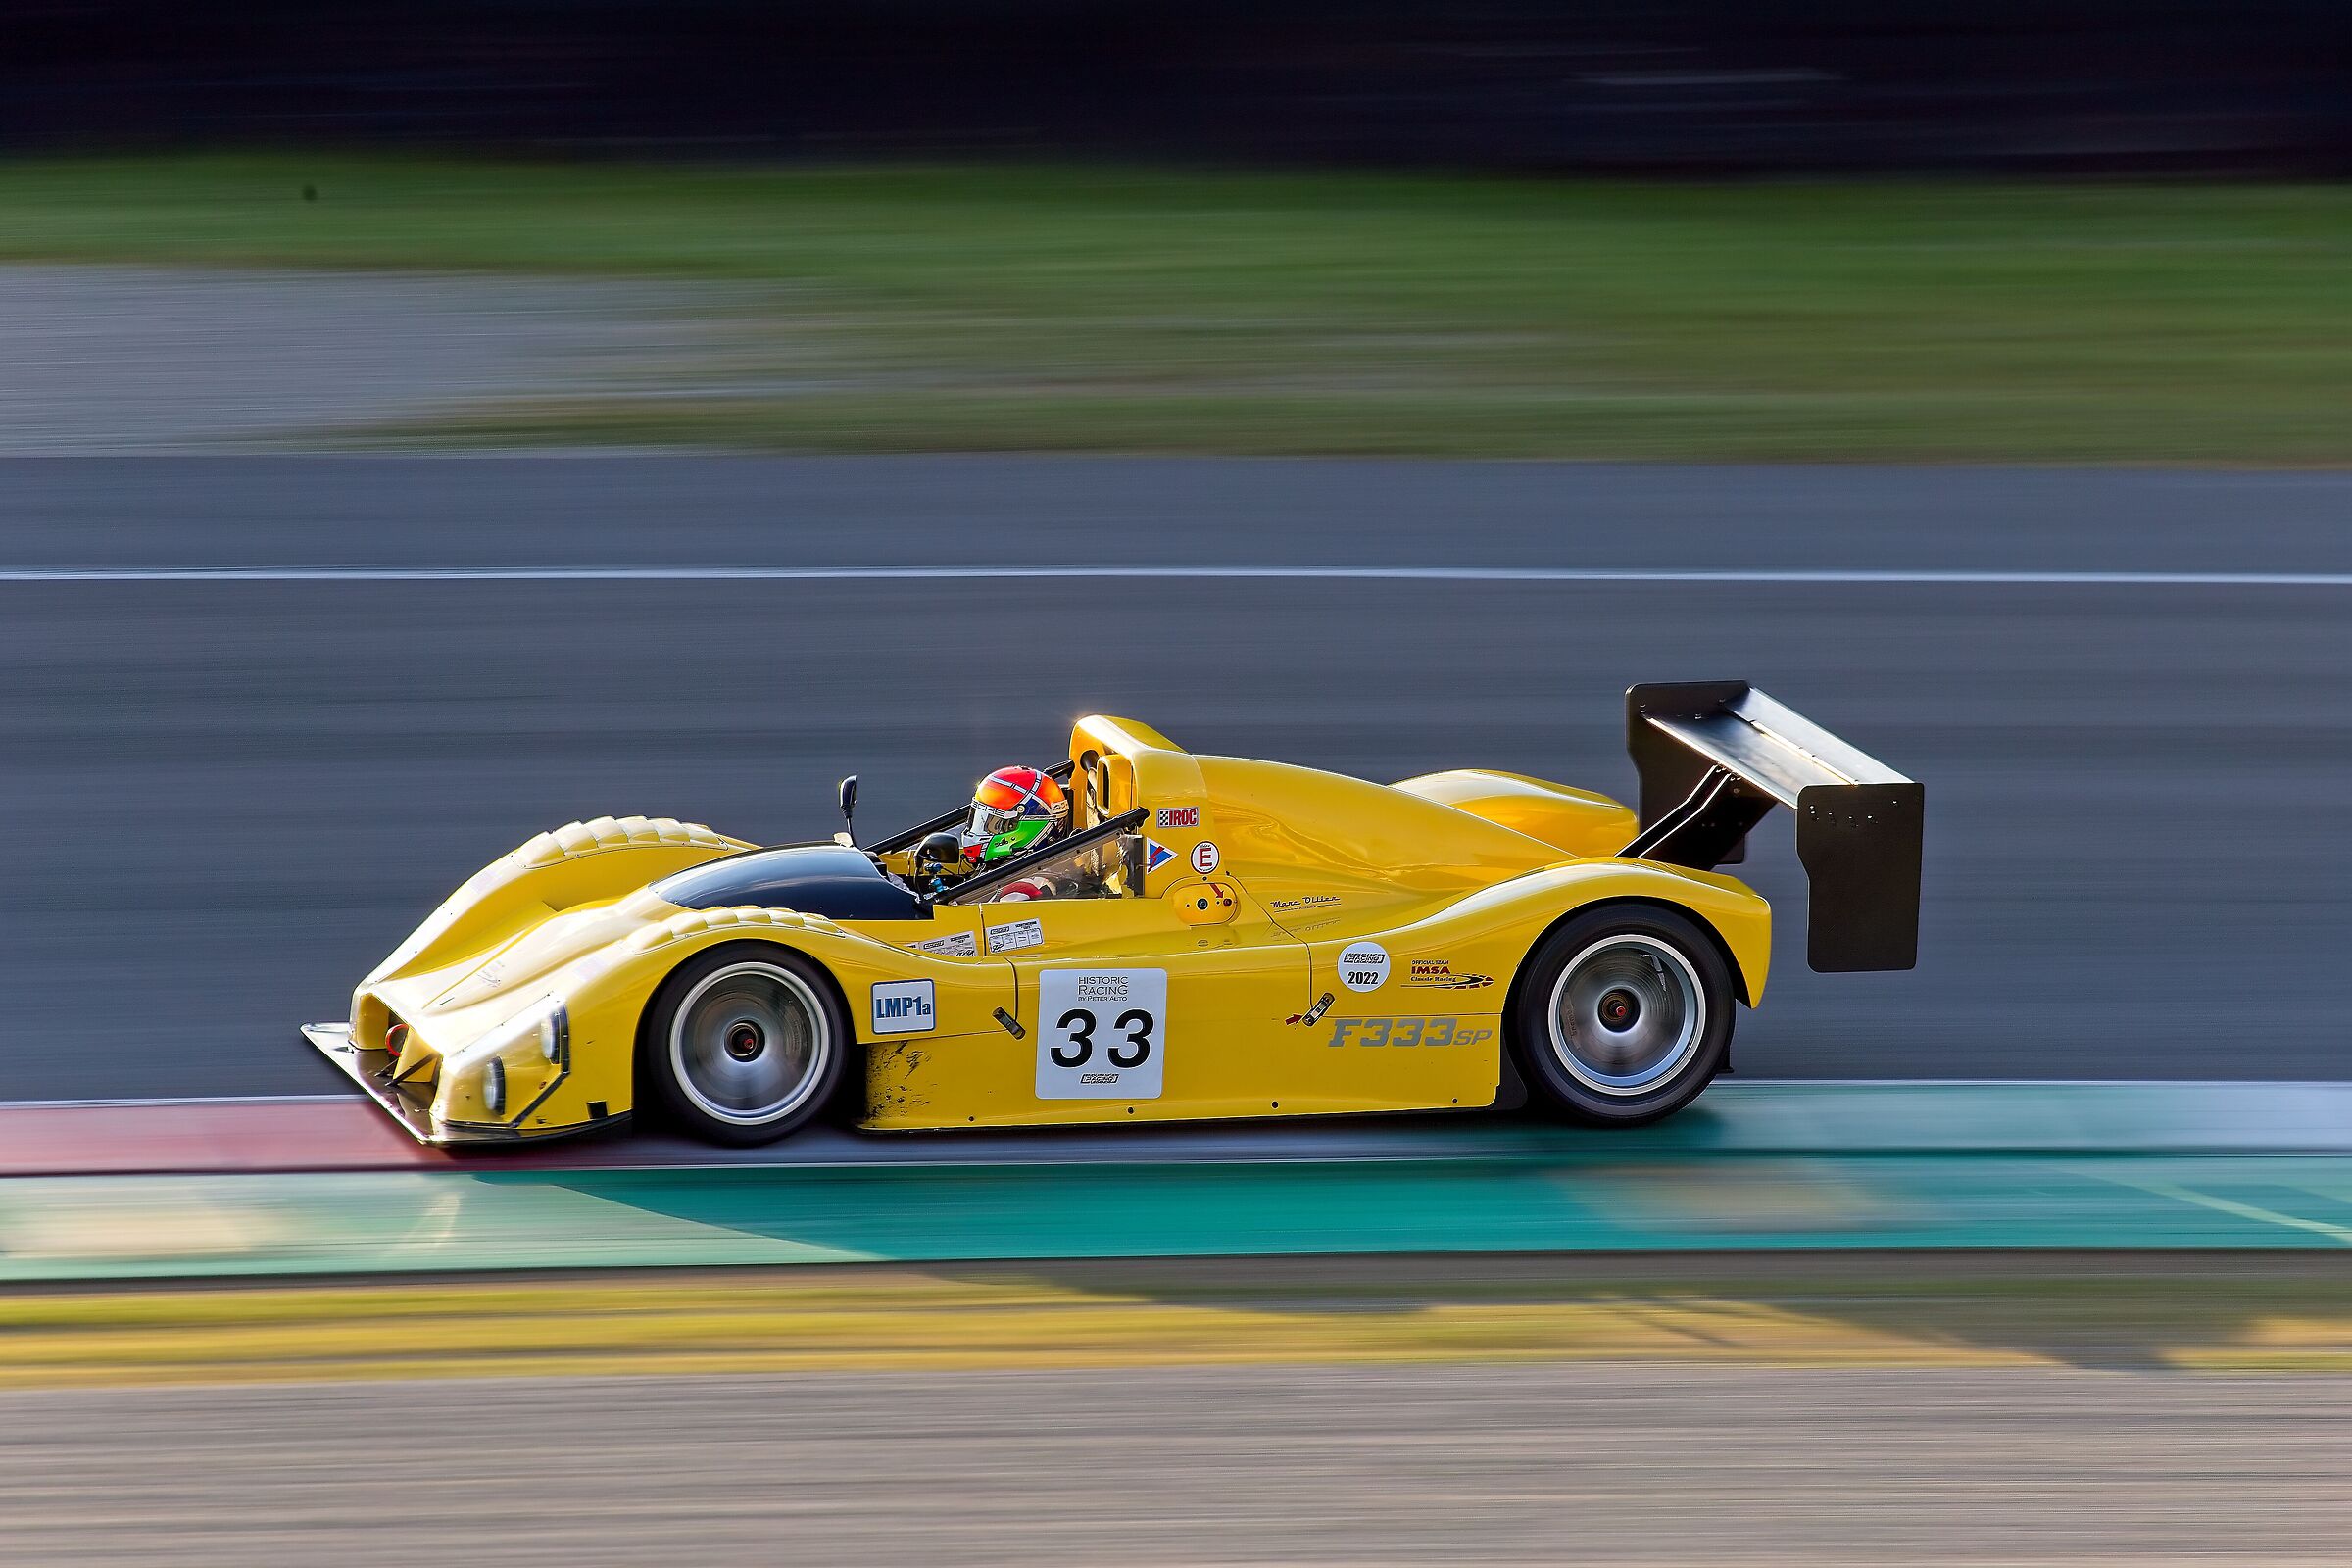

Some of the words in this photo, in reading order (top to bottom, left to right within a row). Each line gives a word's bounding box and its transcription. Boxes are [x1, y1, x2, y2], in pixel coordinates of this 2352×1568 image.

[1169, 809, 1197, 826] IROC
[1199, 848, 1212, 867] E
[1348, 971, 1379, 984] 2022
[1411, 966, 1451, 975] IMSA
[1078, 976, 1129, 985] HISTORIC
[1078, 985, 1129, 995] RACING
[875, 996, 931, 1018] LMP1a
[1050, 1008, 1154, 1069] 33
